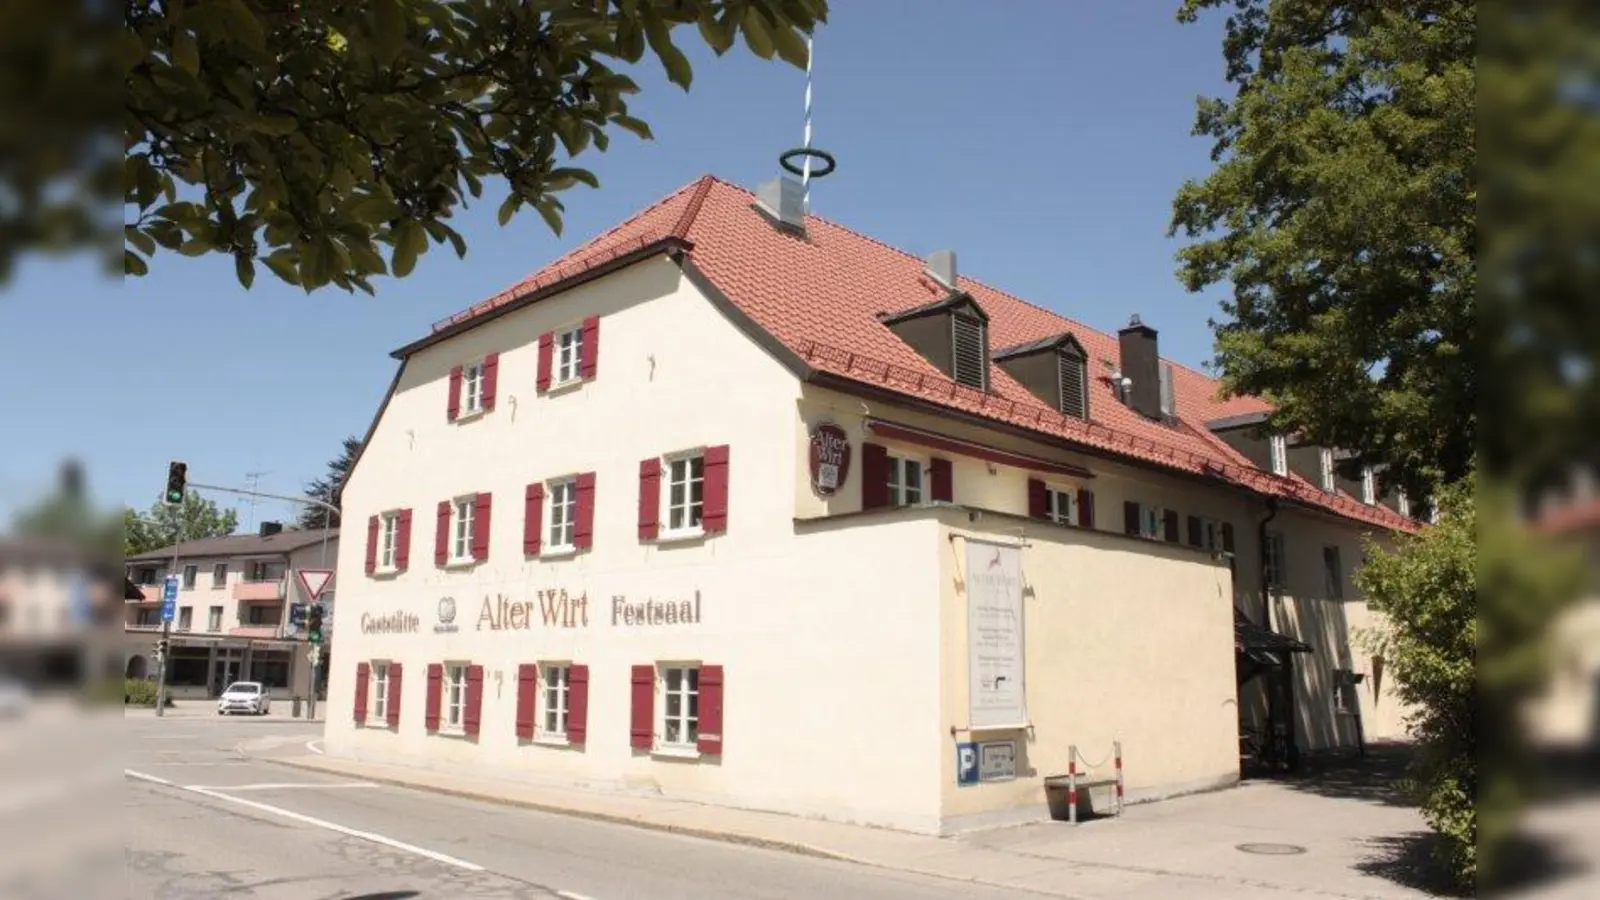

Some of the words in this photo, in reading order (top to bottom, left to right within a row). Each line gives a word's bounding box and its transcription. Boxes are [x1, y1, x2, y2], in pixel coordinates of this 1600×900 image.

[815, 429, 845, 452] Alter
[816, 446, 842, 465] Wirt
[476, 593, 533, 631] Alter
[537, 588, 589, 628] Wirt
[611, 590, 702, 627] Festsaal
[960, 747, 977, 781] P
